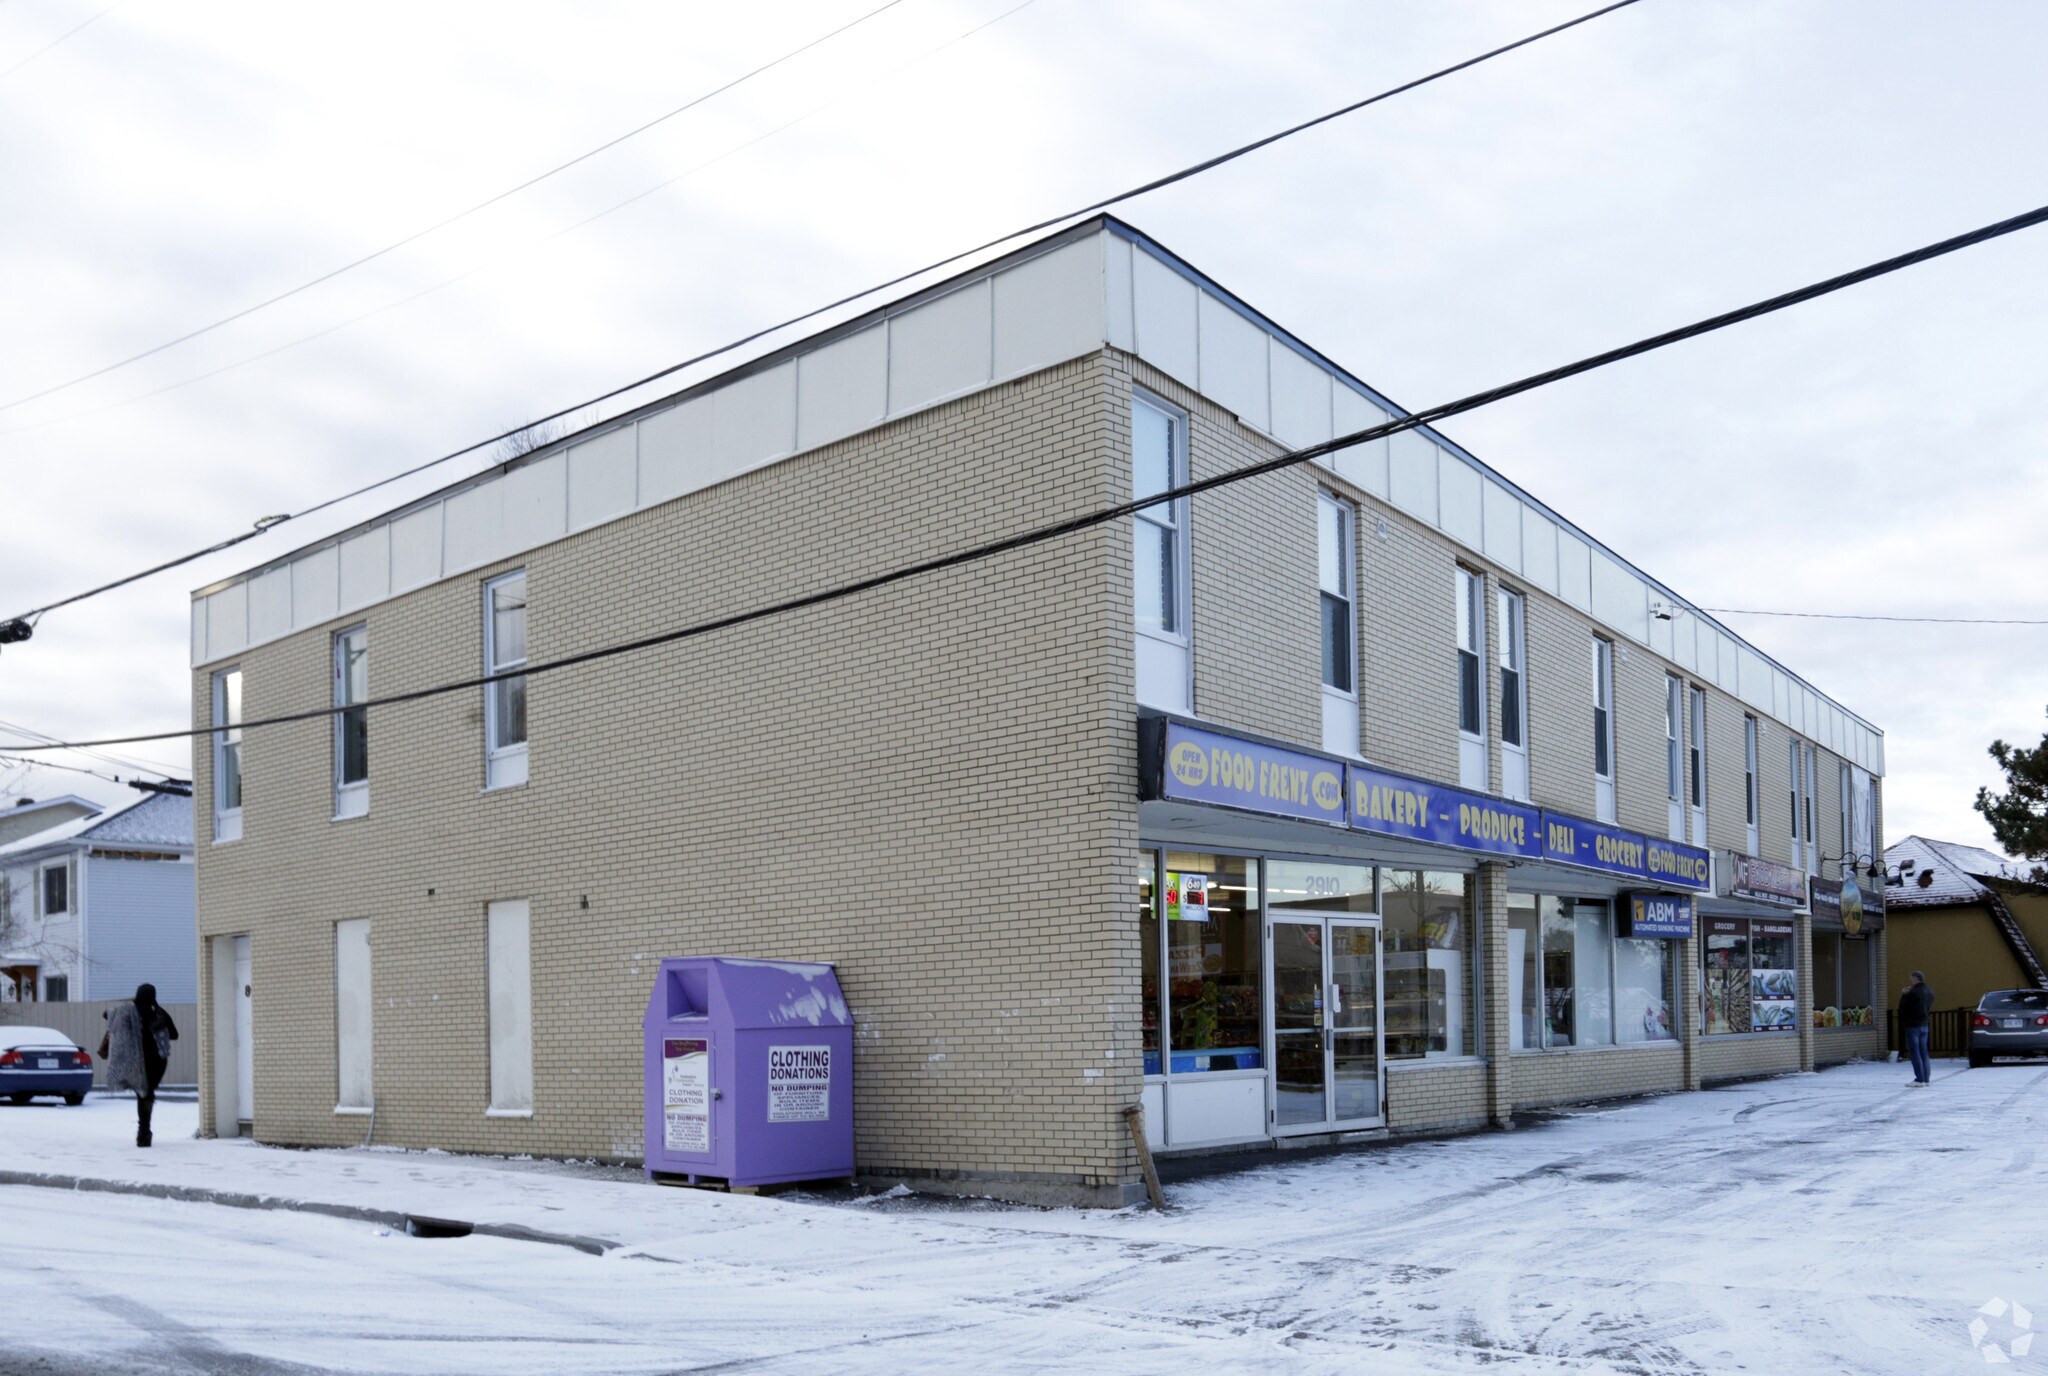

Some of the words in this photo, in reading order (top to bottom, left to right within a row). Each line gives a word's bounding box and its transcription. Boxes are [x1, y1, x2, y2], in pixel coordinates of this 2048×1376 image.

[1181, 749, 1201, 764] OPEN
[1175, 763, 1186, 777] 24
[1188, 766, 1204, 780] HRS
[1211, 747, 1255, 793] FOOD
[1259, 760, 1309, 807] FRENZ
[1316, 780, 1338, 802] .COM
[1355, 780, 1429, 828] BAKERY
[1459, 803, 1525, 846] PRODUCE
[1549, 822, 1575, 855] DELI
[1595, 834, 1643, 869] GROCERY
[1660, 849, 1676, 875] FOOD
[1187, 876, 1201, 890] 649
[1305, 875, 1341, 896] 2910
[1647, 902, 1675, 922] ABM
[1714, 922, 1736, 930] GROCERY
[771, 1050, 829, 1067] CLOTHING
[770, 1067, 829, 1080] DONATIONS
[677, 1114, 707, 1122] DUMPING
